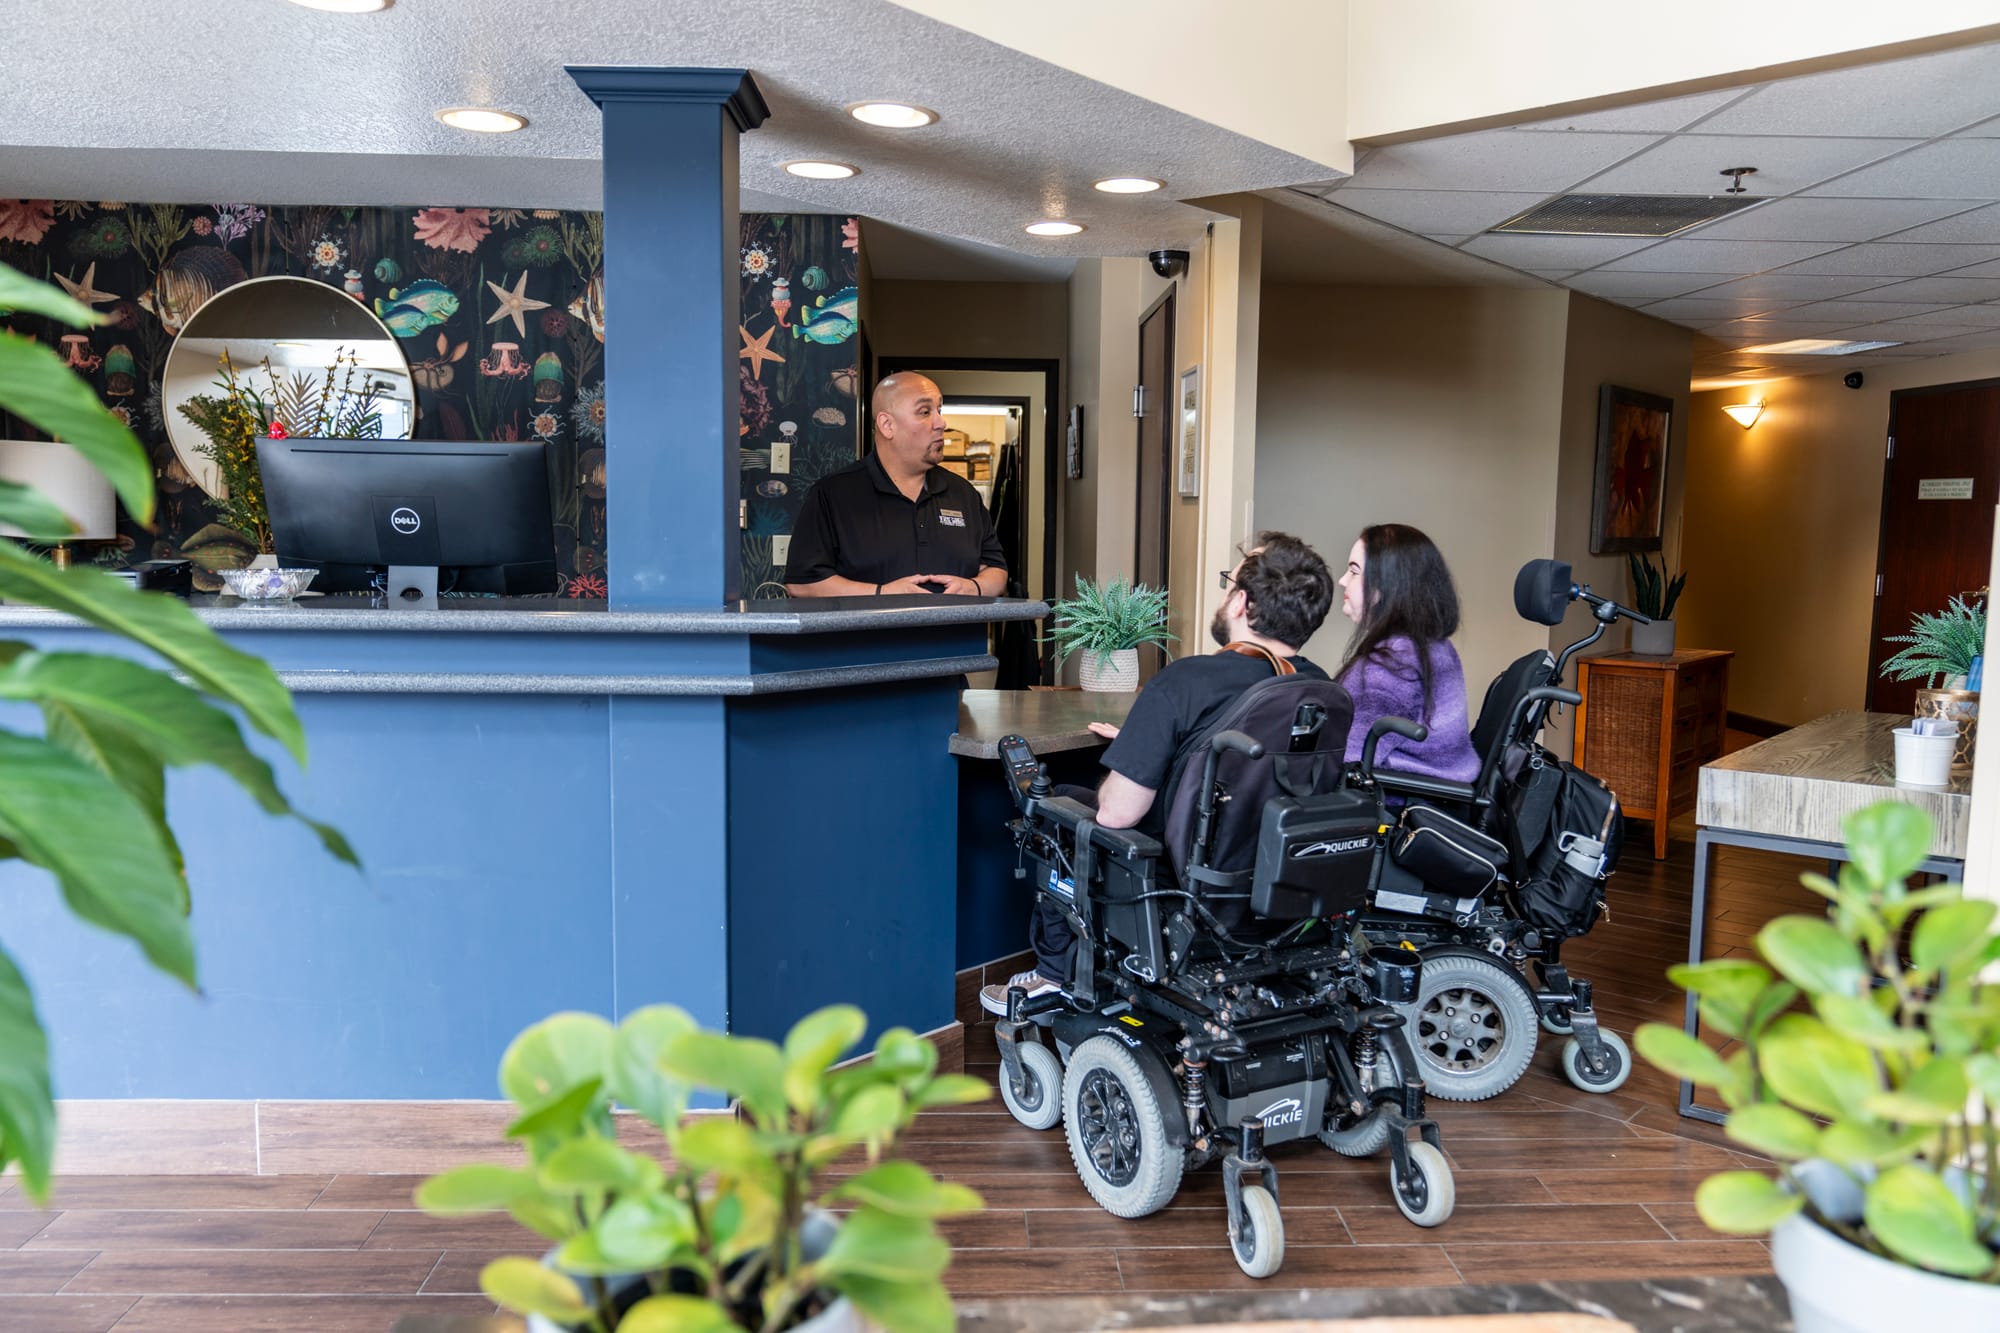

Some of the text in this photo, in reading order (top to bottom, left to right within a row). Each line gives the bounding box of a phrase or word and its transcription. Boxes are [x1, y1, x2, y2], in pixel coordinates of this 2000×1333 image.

[394, 516, 417, 525] DELL
[1329, 838, 1369, 853] QUICKIE
[1263, 1109, 1303, 1128] ICKIE
